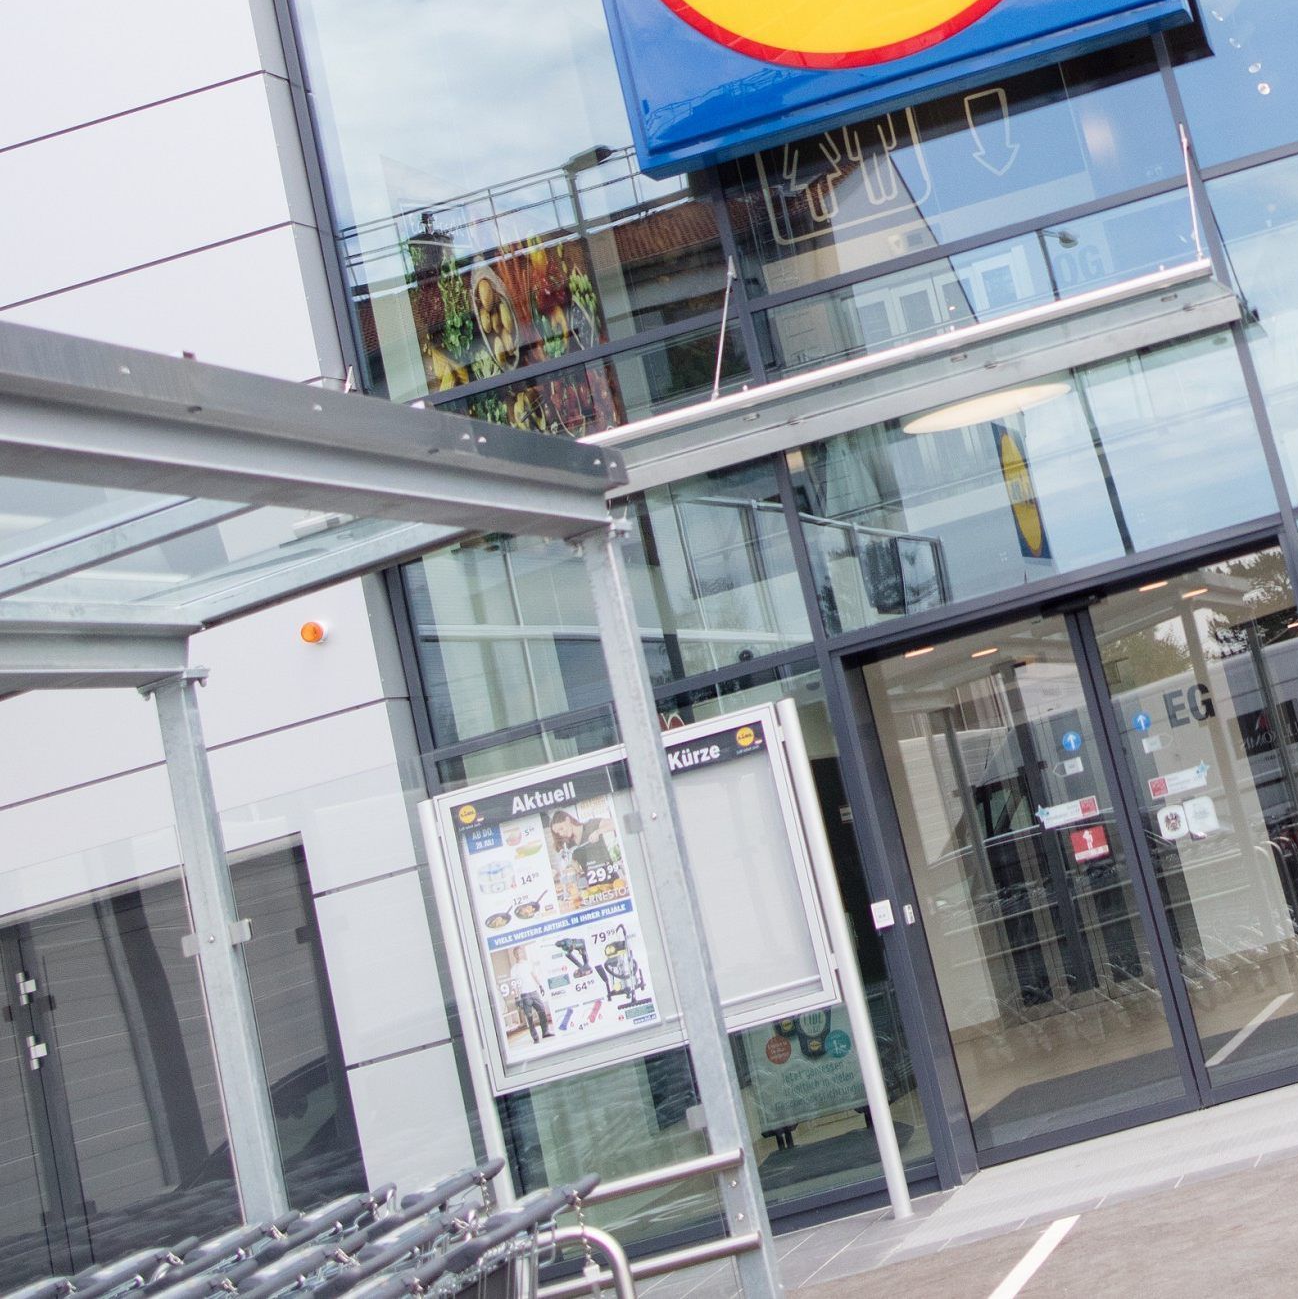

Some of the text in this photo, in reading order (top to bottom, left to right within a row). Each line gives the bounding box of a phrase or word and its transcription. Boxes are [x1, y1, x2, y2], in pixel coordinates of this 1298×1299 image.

[1162, 683, 1215, 728] EG
[667, 744, 721, 771] Kürze
[512, 781, 576, 815] Aktuell
[494, 903, 627, 946] VIELE WEITERE ARTIKEL IN IHRER FILIALE
